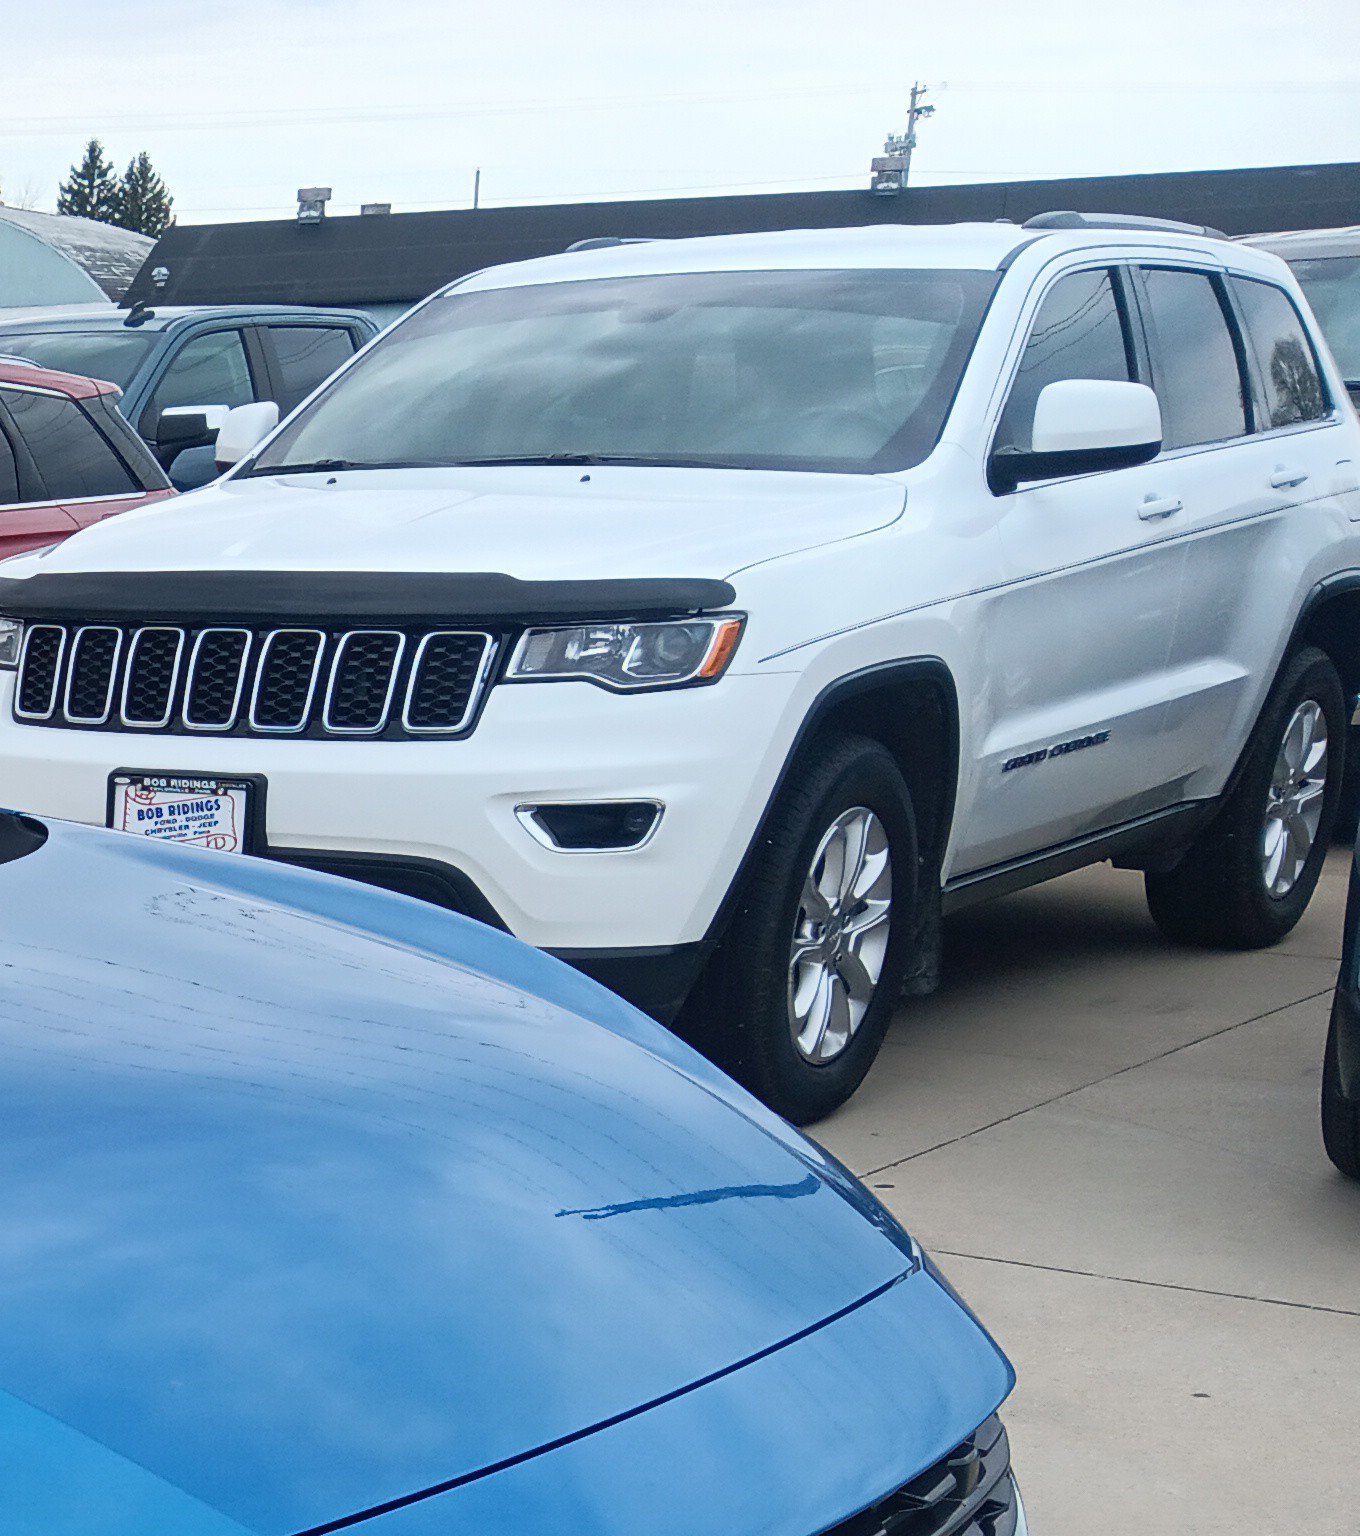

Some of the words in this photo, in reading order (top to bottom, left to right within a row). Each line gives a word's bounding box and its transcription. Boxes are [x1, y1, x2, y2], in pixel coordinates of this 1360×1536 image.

[143, 777, 167, 787] BOB
[170, 778, 217, 790] RIDINGS
[137, 807, 164, 821] BOB
[168, 798, 221, 817] RIDINGS
